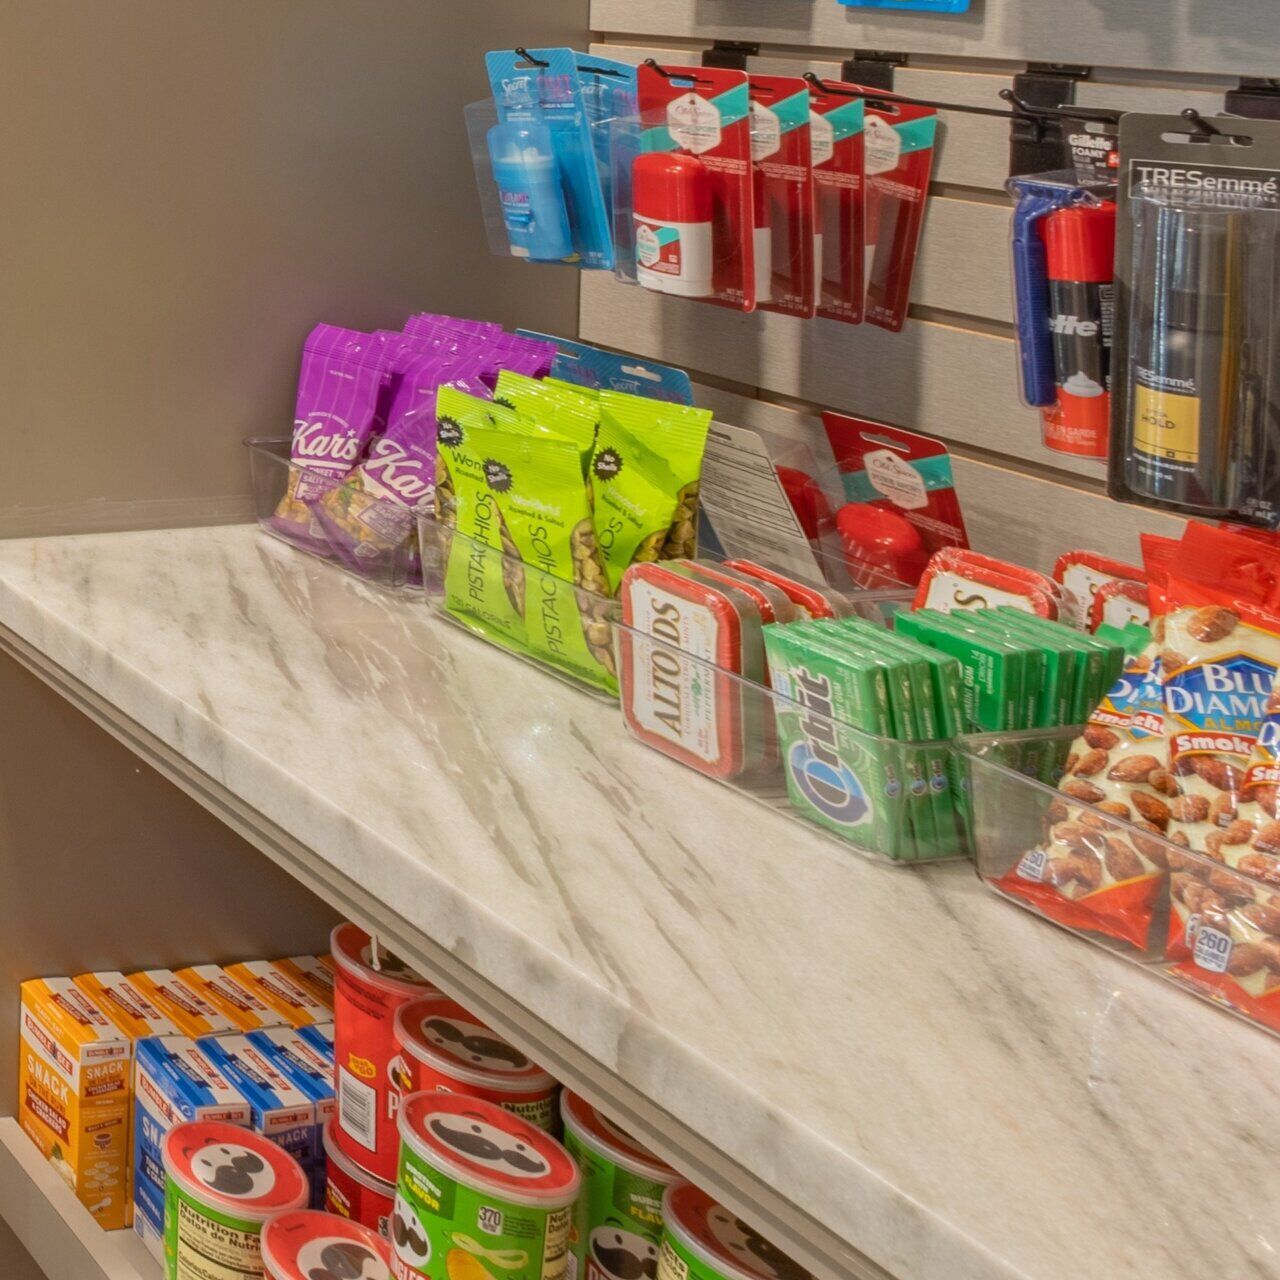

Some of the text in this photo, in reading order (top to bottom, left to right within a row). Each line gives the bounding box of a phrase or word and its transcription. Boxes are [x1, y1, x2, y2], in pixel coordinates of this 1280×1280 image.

[501, 76, 532, 97] Secret
[1068, 134, 1112, 151] Gillette
[1136, 167, 1278, 195] TRESemmé
[452, 451, 484, 472] Won
[489, 464, 500, 473] No
[597, 461, 619, 472] Shells
[603, 454, 615, 463] No
[487, 472, 508, 483] Shells
[467, 490, 494, 603] PISTACHIOS
[528, 523, 567, 656] PISTACHIOS
[1200, 930, 1229, 954] 260
[25, 1013, 73, 1076] BUMBLE BEE
[26, 1053, 69, 1106] SNACK
[86, 1060, 124, 1079] SNACK
[403, 1176, 441, 1212] FLAVOR
[180, 1201, 262, 1244] Nutrition Fa
[479, 1206, 502, 1221] 370
[180, 1211, 208, 1233] Datos
[210, 1230, 225, 1243] de
